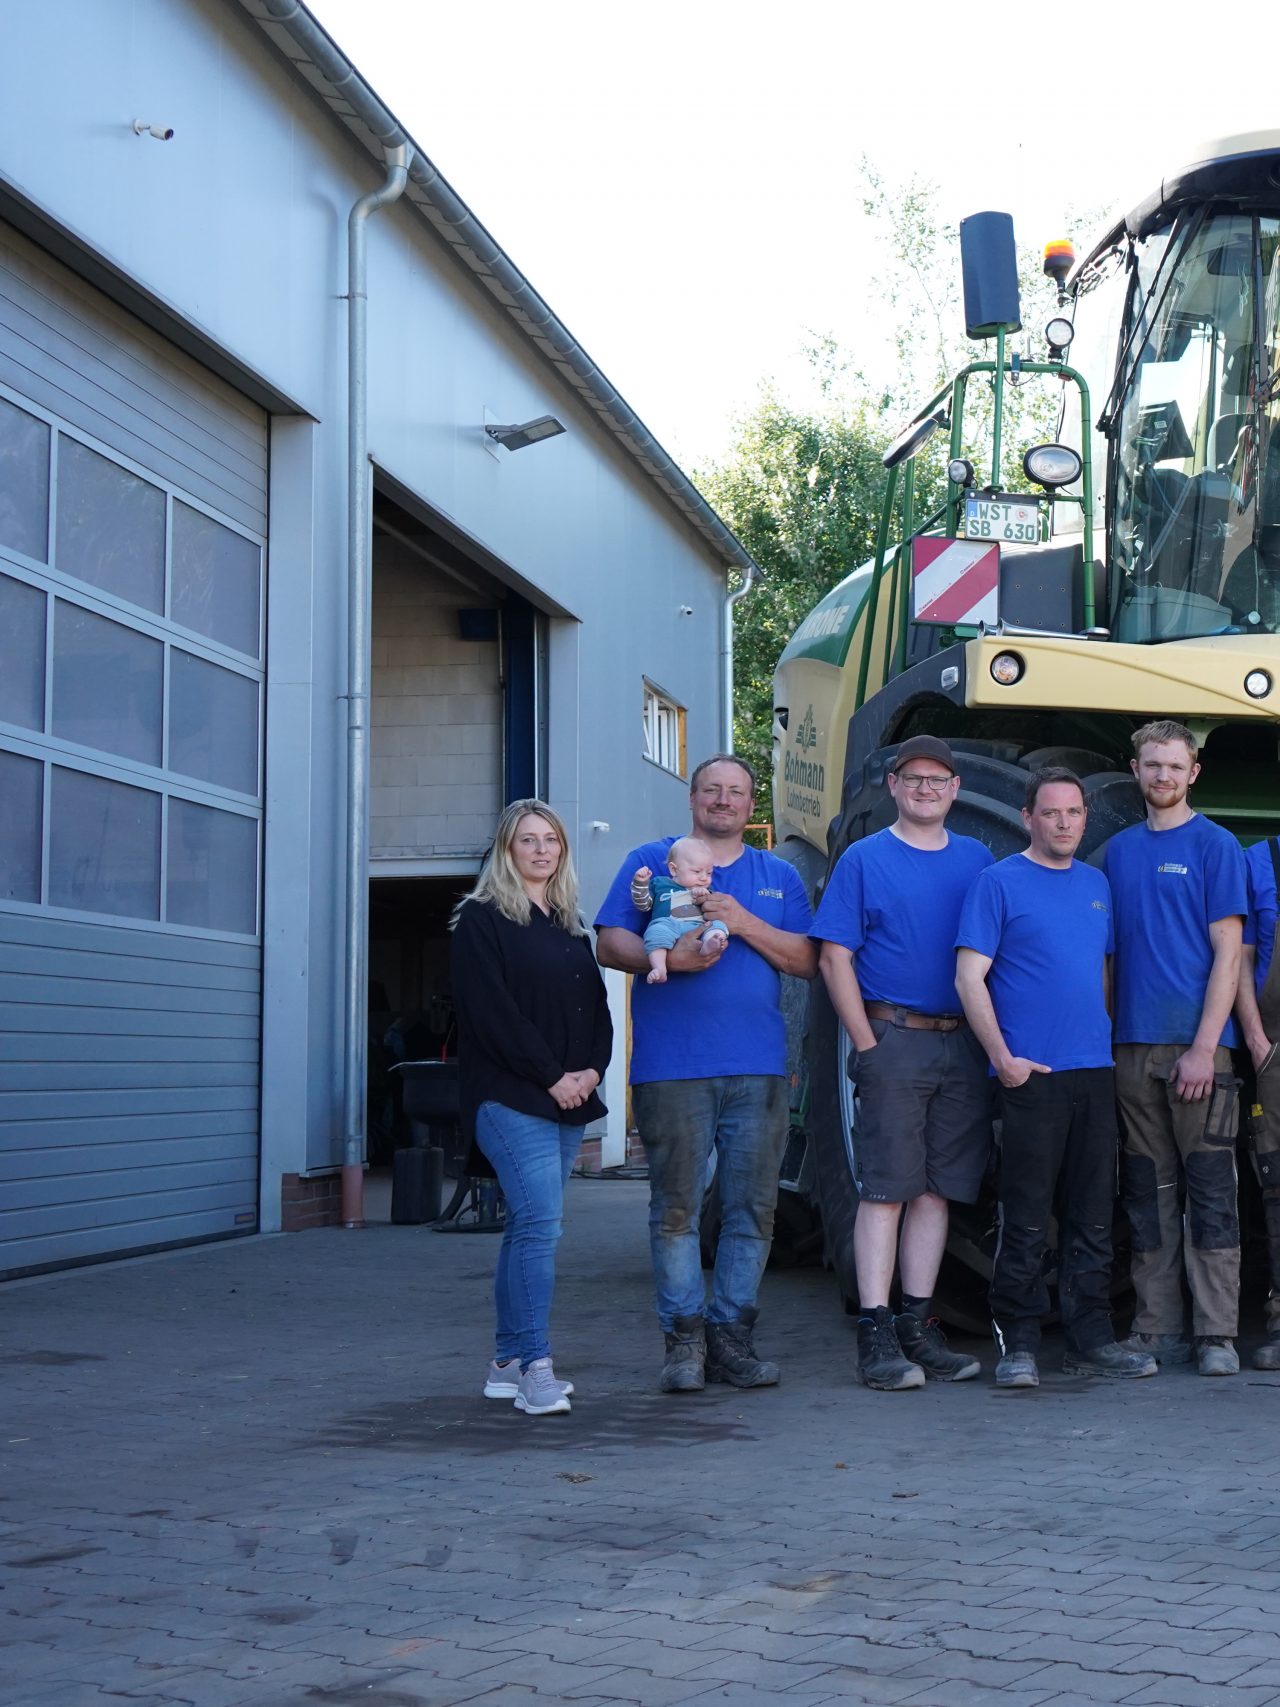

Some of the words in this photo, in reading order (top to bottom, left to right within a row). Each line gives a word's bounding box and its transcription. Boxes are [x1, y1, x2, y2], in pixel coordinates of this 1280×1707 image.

[979, 503, 1011, 521] WST
[969, 520, 991, 536] SB
[1004, 523, 1034, 540] 630
[785, 750, 824, 792] Bohmann
[787, 787, 821, 817] Lohnbetrieb
